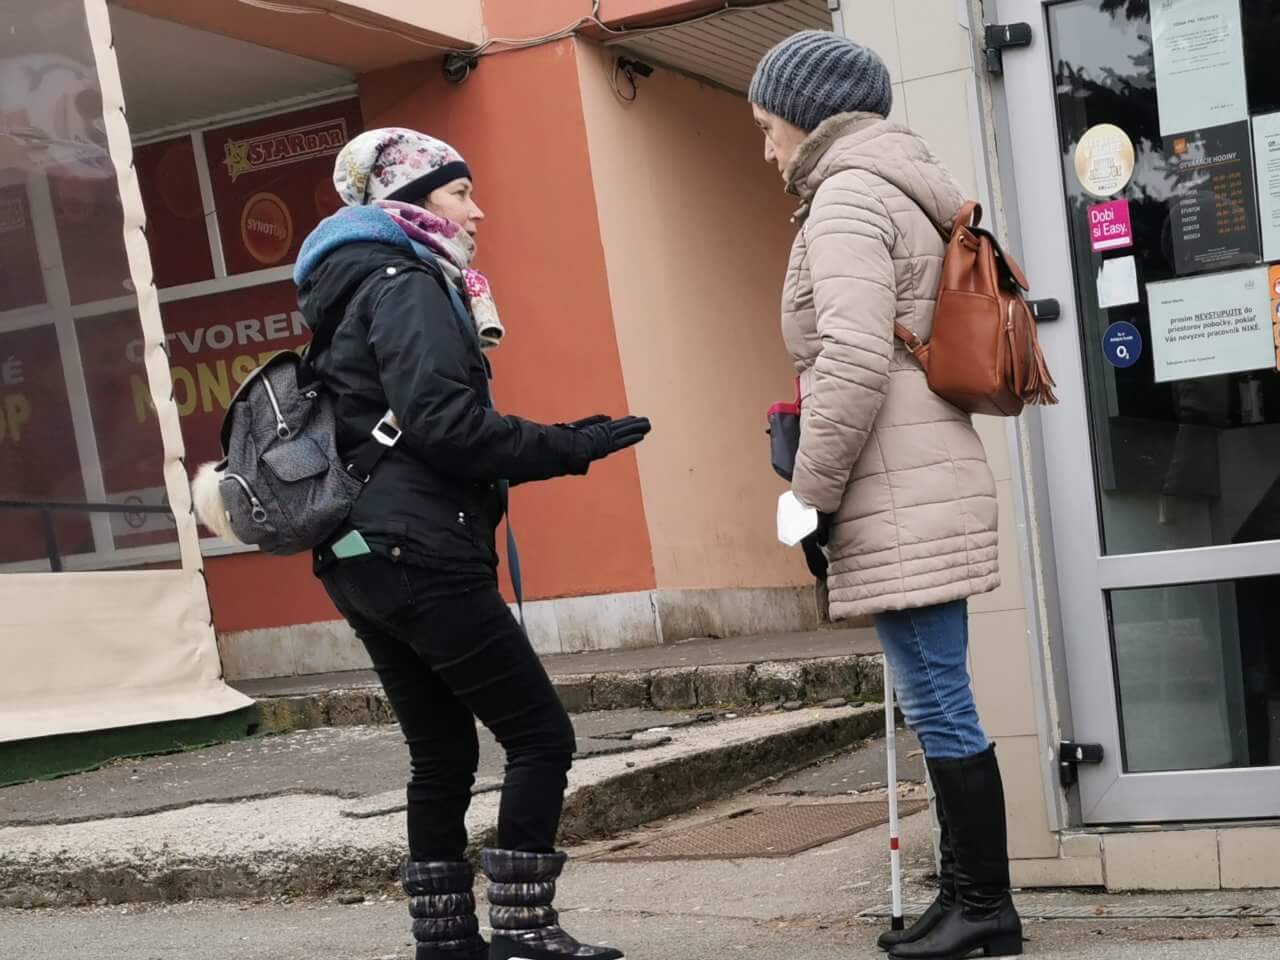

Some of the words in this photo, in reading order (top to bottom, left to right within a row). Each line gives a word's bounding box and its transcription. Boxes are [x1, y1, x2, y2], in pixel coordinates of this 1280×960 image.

[1091, 207, 1114, 223] Dobi
[1093, 224, 1101, 238] si
[1103, 222, 1128, 236] Easy.
[1194, 307, 1242, 320] NEVSTUPUJTE
[1243, 306, 1253, 314] do
[1167, 323, 1201, 334] priestorov
[126, 310, 314, 364] OTVOREN
